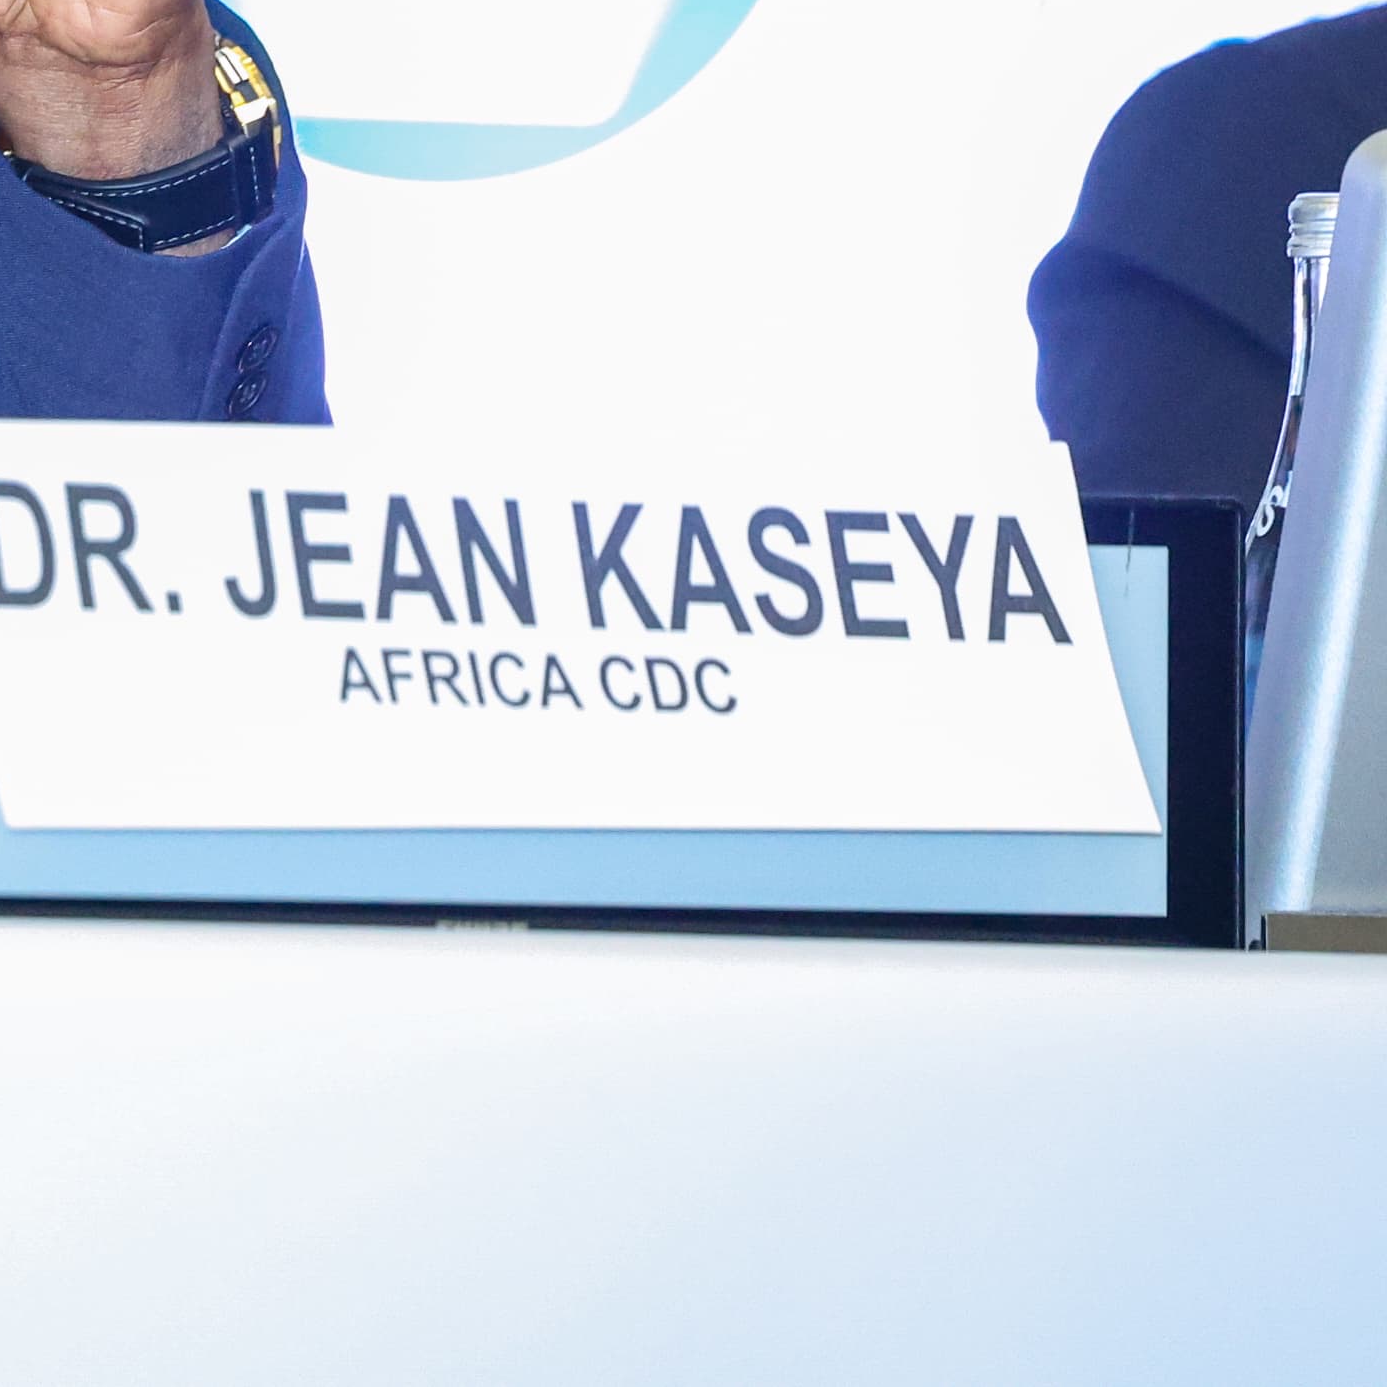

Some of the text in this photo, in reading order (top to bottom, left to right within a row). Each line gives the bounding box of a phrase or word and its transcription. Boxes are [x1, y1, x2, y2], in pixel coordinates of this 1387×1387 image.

[223, 488, 539, 629] JEAN
[570, 500, 1074, 647] KASEYA
[339, 645, 739, 716] AFRICA CDC
